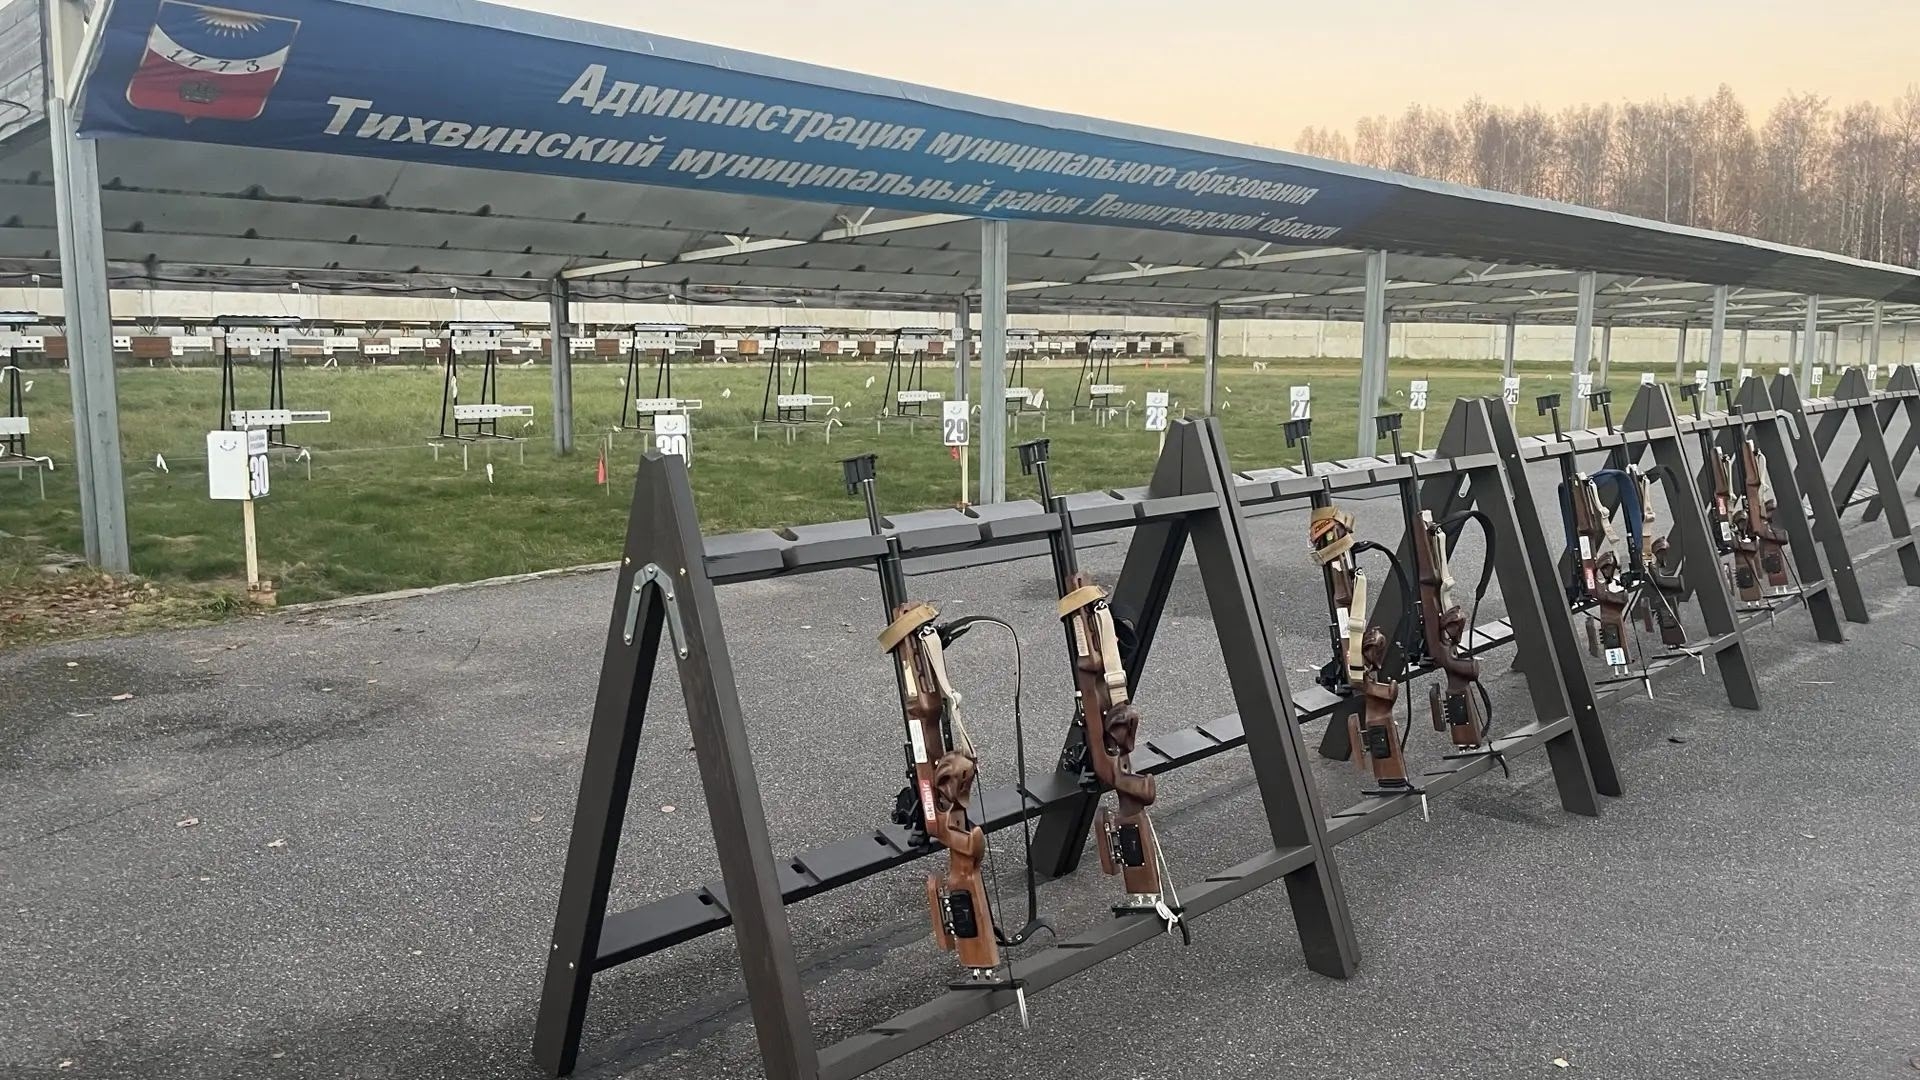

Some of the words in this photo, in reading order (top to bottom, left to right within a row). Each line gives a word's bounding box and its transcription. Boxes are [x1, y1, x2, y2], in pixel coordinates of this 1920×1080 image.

[166, 49, 260, 72] 1773
[557, 63, 926, 151] Администрация
[924, 132, 1176, 187] муниципального
[1174, 167, 1320, 205] образования
[323, 96, 667, 167] Тихвинский
[668, 149, 996, 205] муниципальный
[983, 188, 1085, 214] район
[1079, 193, 1269, 231] Ленинградской
[1258, 216, 1341, 240] области
[1410, 392, 1427, 410] 26
[1504, 387, 1519, 403] 25
[1146, 407, 1168, 431] 28
[1291, 400, 1310, 418] 27
[945, 418, 968, 443] 29
[250, 454, 270, 498] 30
